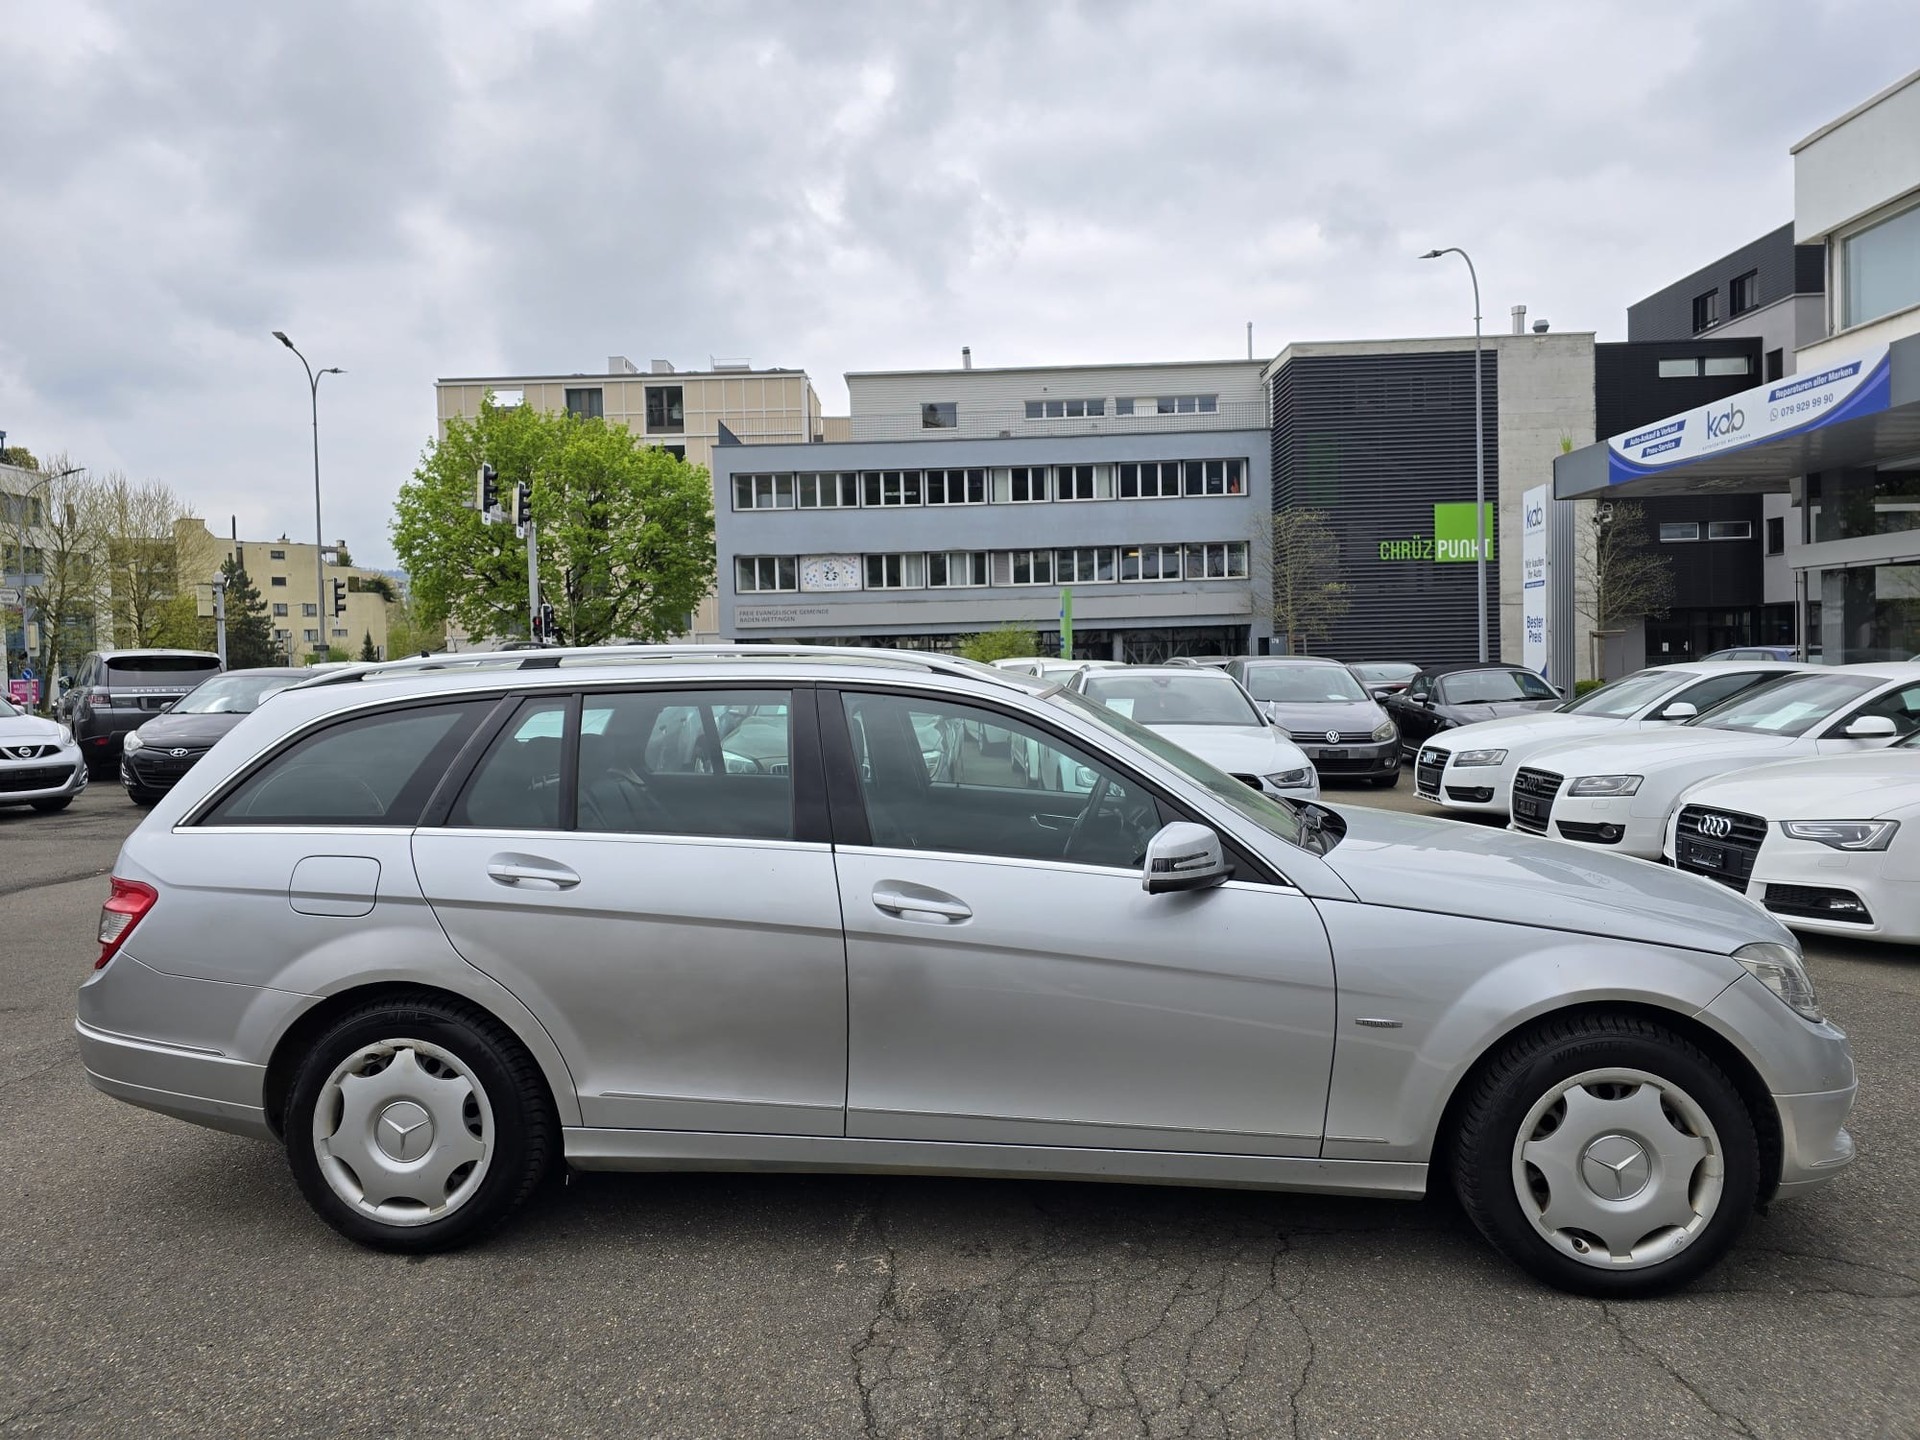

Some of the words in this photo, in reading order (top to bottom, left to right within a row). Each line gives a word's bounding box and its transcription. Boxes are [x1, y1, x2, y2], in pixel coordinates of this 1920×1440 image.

[1828, 366, 1853, 381] Marken
[1781, 405, 1795, 417] 079
[1796, 401, 1811, 413] 929
[1812, 397, 1822, 407] 99
[1823, 393, 1834, 404] 90
[1707, 403, 1745, 440] kab
[1379, 535, 1432, 560] CHRÜZ
[1526, 615, 1544, 629] Bester
[1528, 629, 1542, 643] Preis
